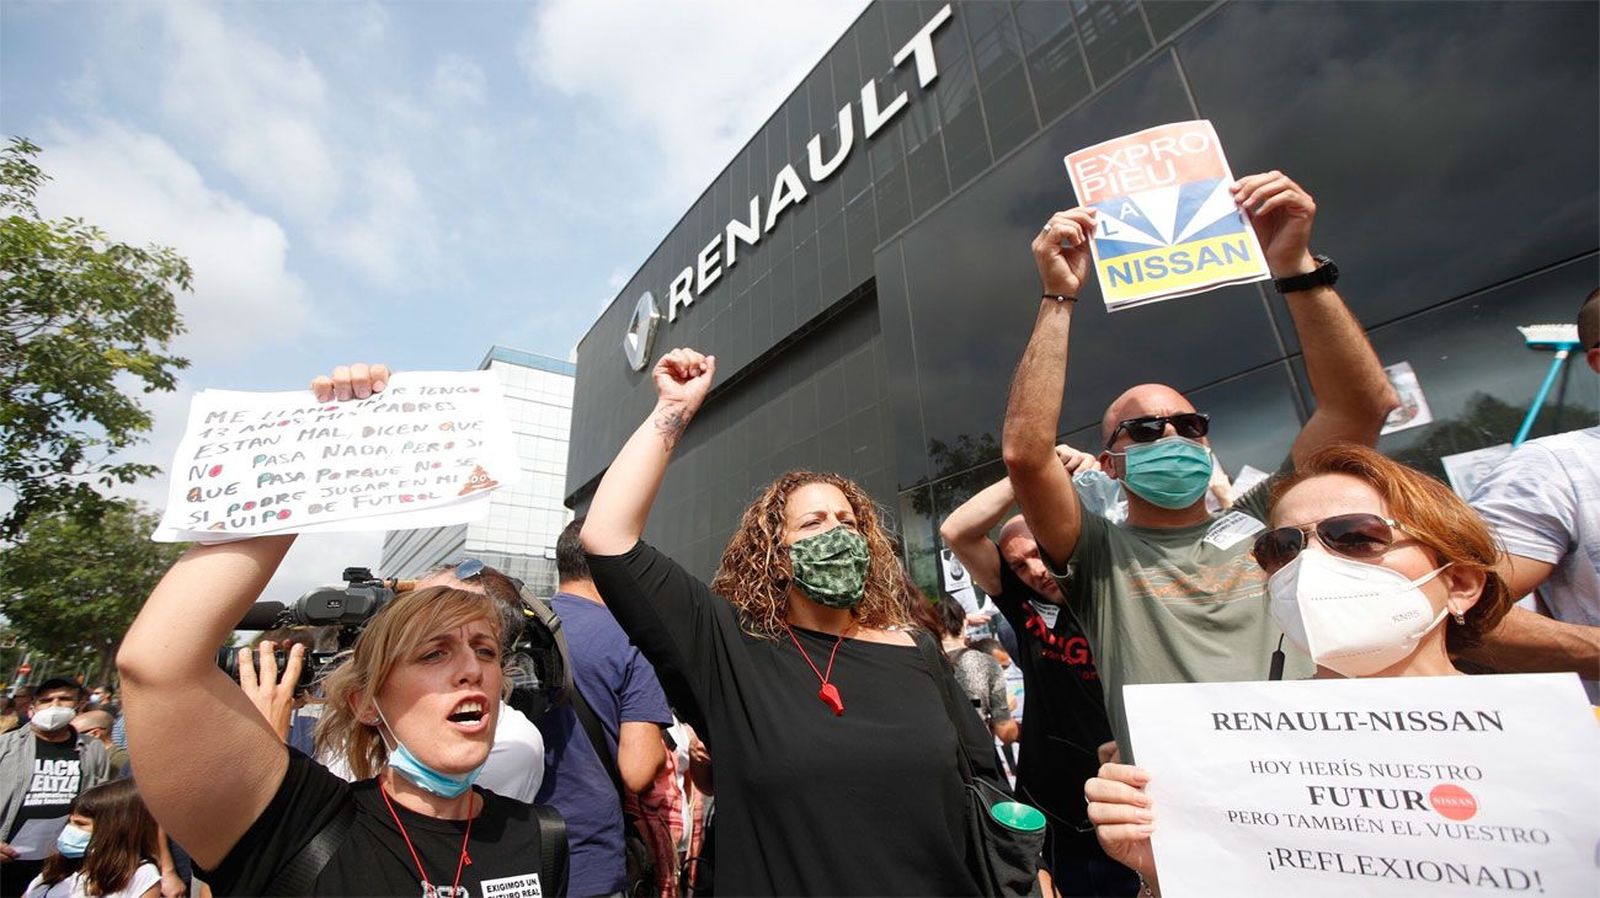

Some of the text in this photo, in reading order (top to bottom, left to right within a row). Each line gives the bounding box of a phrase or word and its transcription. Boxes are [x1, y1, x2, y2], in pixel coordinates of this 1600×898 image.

[668, 3, 952, 323] RENAULT
[1075, 131, 1209, 182] EXPRO
[1081, 158, 1176, 201] PIEU
[1107, 239, 1250, 288] NISSAN
[205, 410, 249, 424] ME
[419, 385, 480, 396] TENGO
[373, 401, 457, 414] PADRES
[188, 463, 224, 481] NO
[252, 451, 306, 469] PASA
[401, 439, 456, 454] PERO
[467, 438, 483, 448] SI
[193, 434, 282, 461] ESTAN
[361, 423, 429, 438] DICEN
[438, 420, 485, 433] QUE
[186, 457, 478, 503] QUE PASA PORQUE NO SE
[188, 474, 458, 525] SI PODRE JUGAR EN MI
[308, 501, 338, 515] DE
[1211, 709, 1504, 732] RENAULT-NISSAN
[1250, 758, 1483, 781] HOY HERÍS NUESTRO
[1306, 785, 1429, 812] FUTUR
[1227, 809, 1551, 846] PERO TAMBIÉN EL VUESTRO
[486, 878, 537, 893] EXIGIMOS UN
[1266, 846, 1545, 893] ¡REFLEXIONAD!
[522, 888, 540, 897] REAL
